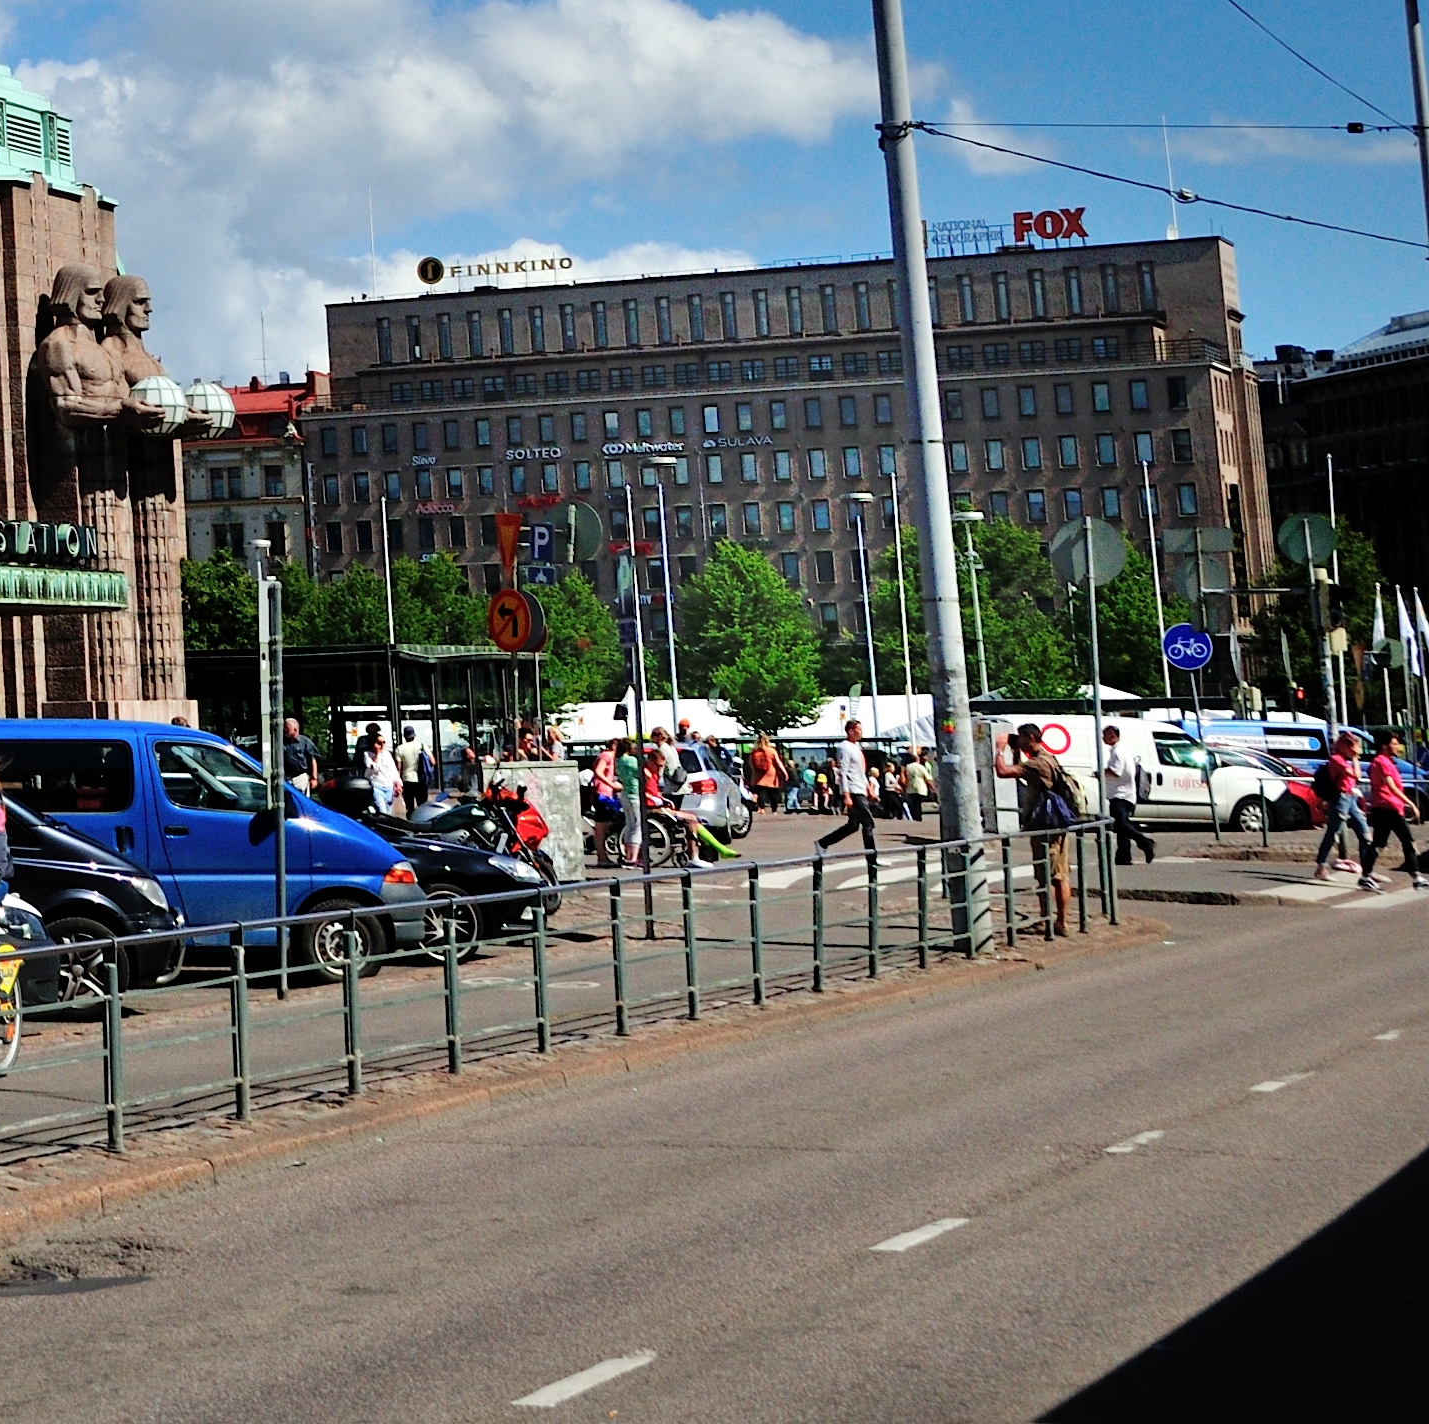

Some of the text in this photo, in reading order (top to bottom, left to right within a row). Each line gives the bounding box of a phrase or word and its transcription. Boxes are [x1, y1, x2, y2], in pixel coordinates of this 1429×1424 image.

[931, 219, 987, 232] NATIONAL
[1012, 206, 1089, 243] FOX
[931, 230, 1005, 245] GEOGRAPHIC
[449, 257, 573, 277] FINNKINO
[626, 440, 685, 454] Meltwater
[717, 435, 774, 448] SULAVA
[415, 502, 456, 515] Adecco
[534, 526, 550, 559] P
[1173, 778, 1209, 790] FUJITS
